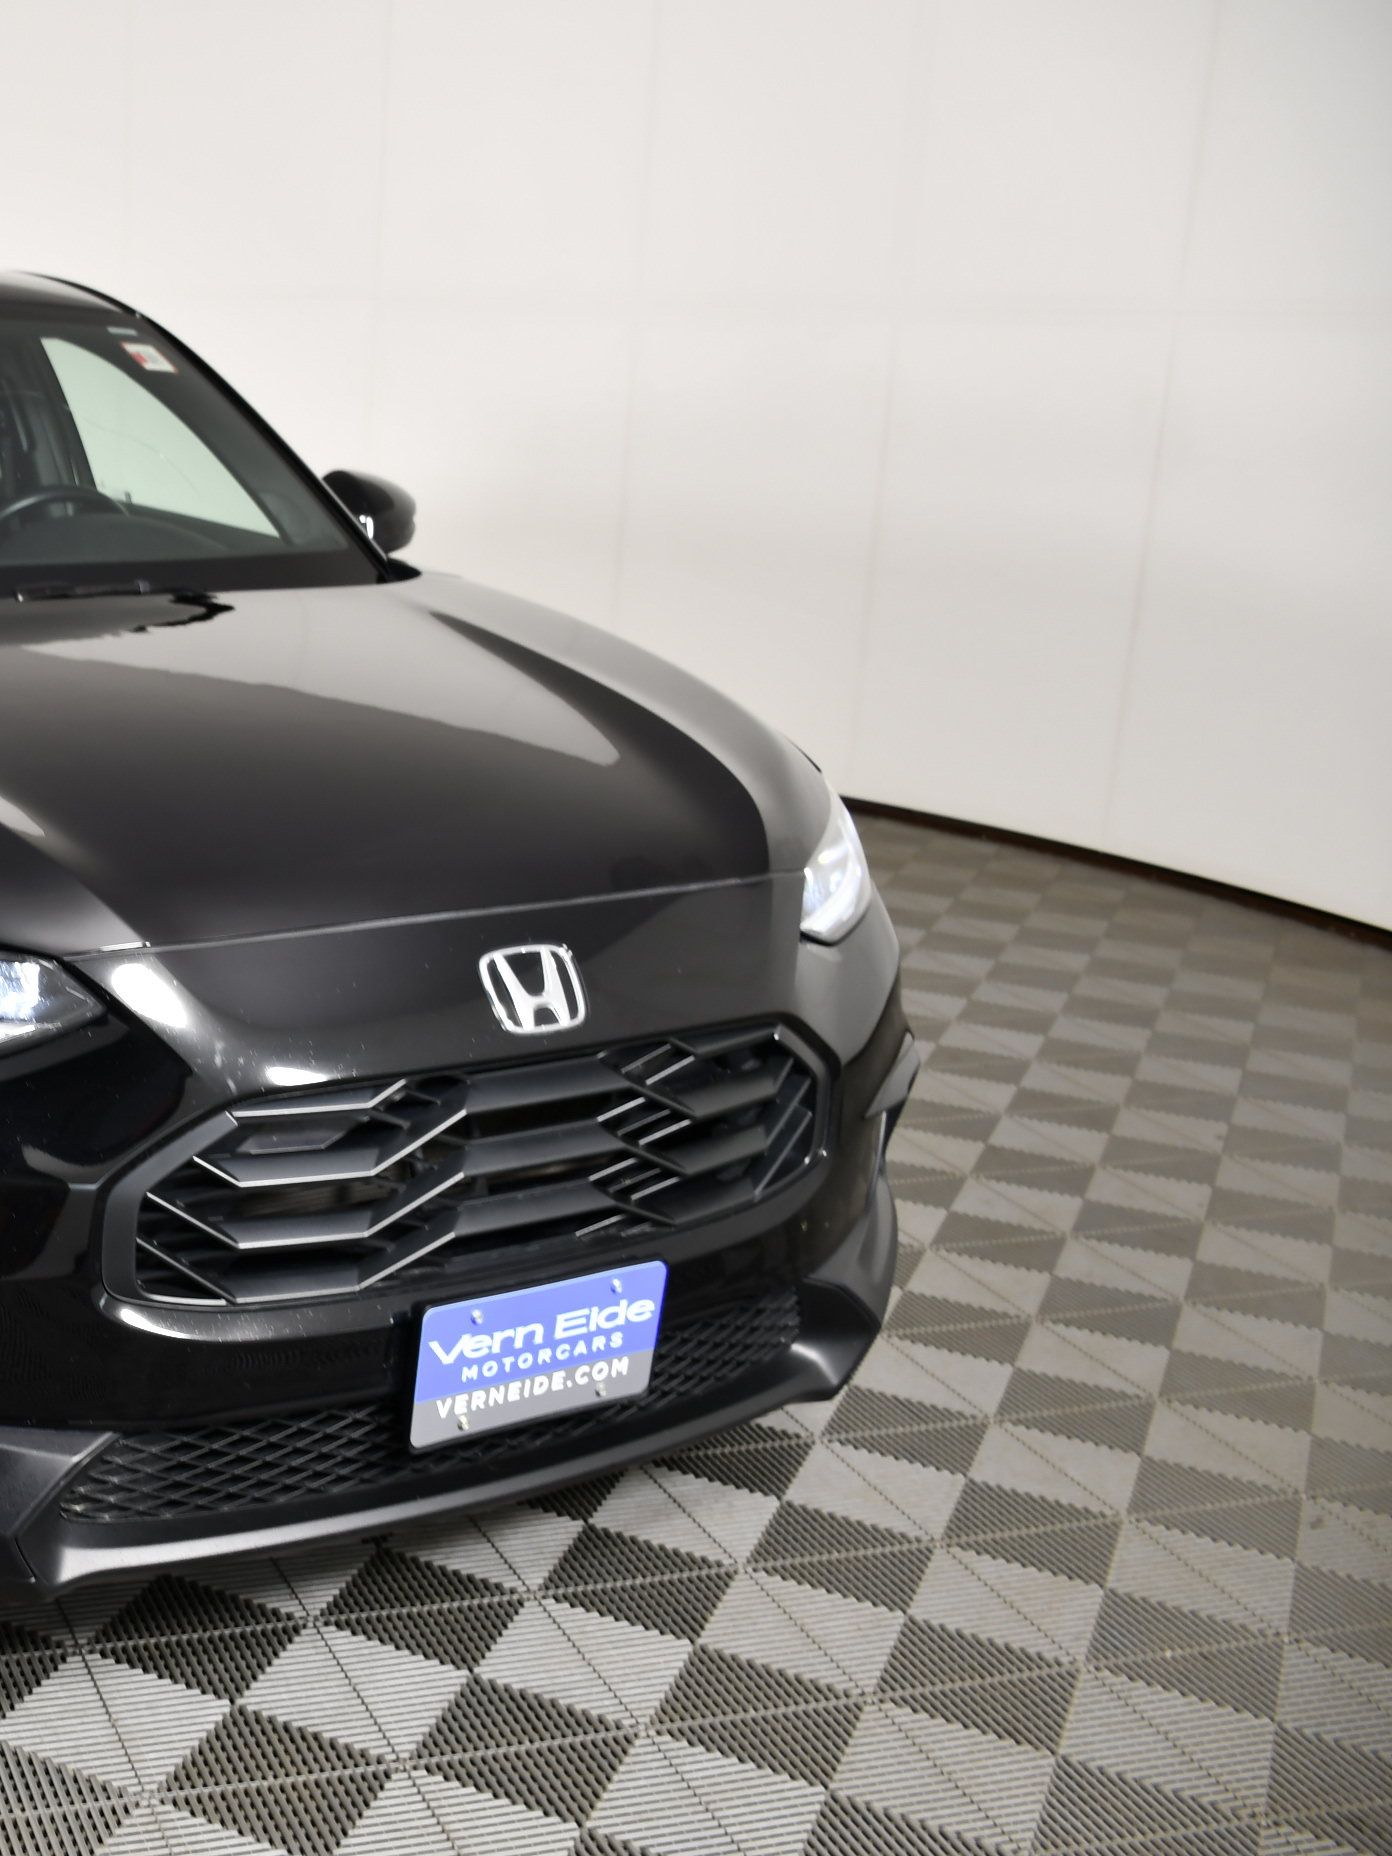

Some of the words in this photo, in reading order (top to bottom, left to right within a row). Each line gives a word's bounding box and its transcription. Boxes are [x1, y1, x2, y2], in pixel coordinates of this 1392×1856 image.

[428, 1322, 544, 1365] Vern
[461, 1331, 623, 1382] MOTORCARS
[436, 1356, 629, 1418] VERNEIDE.COM
